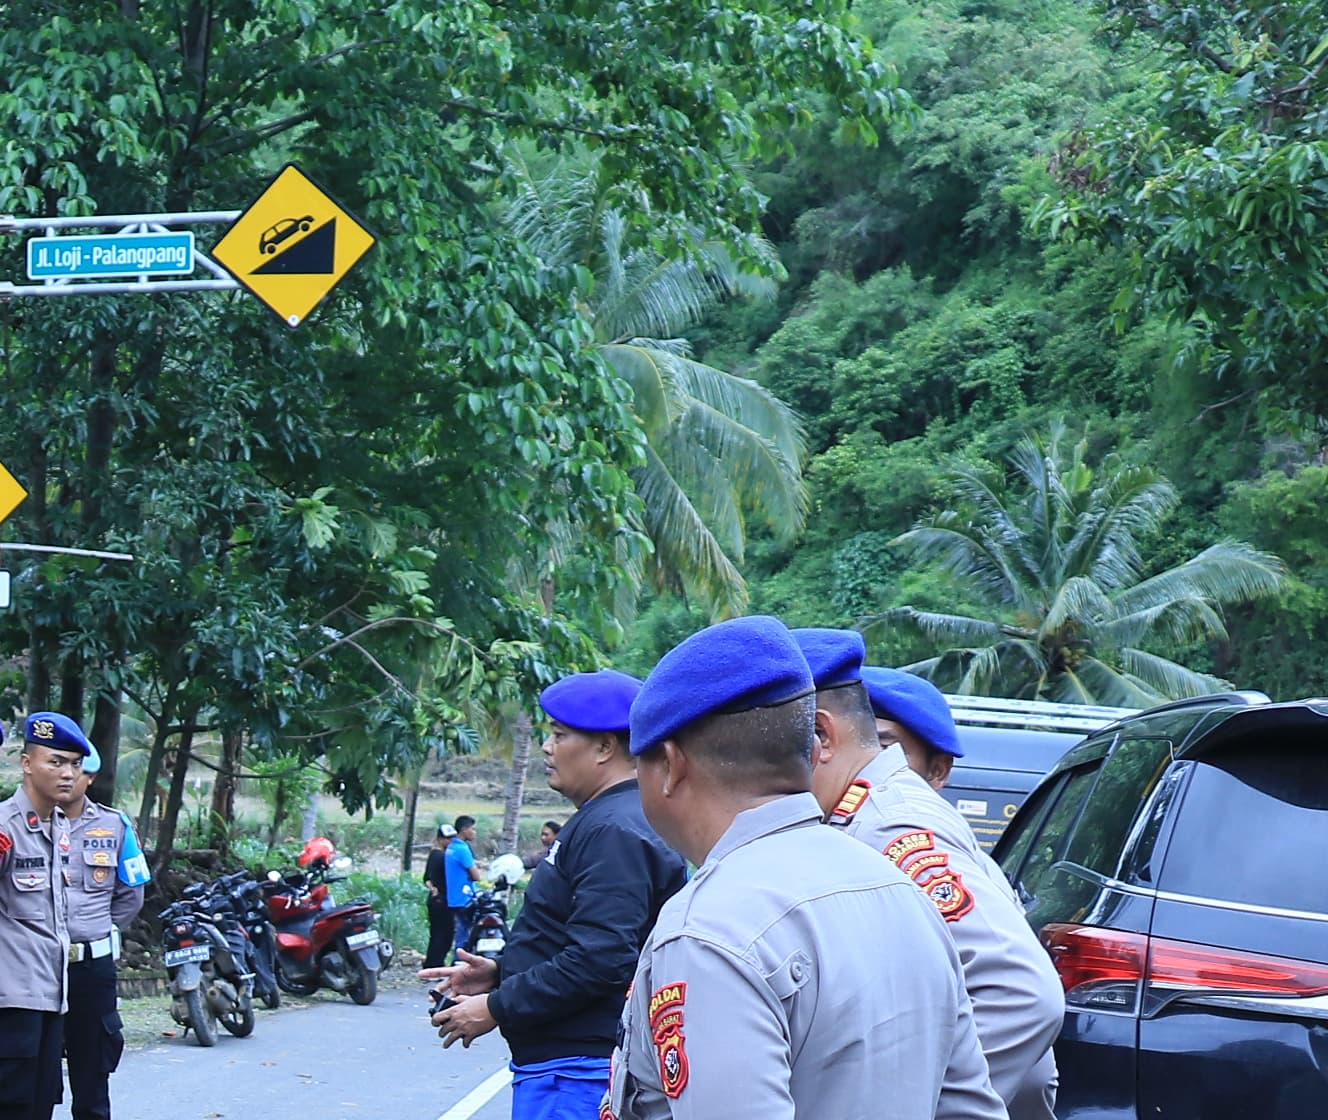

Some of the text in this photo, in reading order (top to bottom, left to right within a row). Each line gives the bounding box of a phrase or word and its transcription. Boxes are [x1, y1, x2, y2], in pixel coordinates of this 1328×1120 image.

[36, 248, 52, 267] Jl.
[55, 246, 82, 271] Loji
[93, 245, 186, 268] Palangpang
[83, 839, 117, 849] POLRI
[888, 833, 928, 856] OLRES
